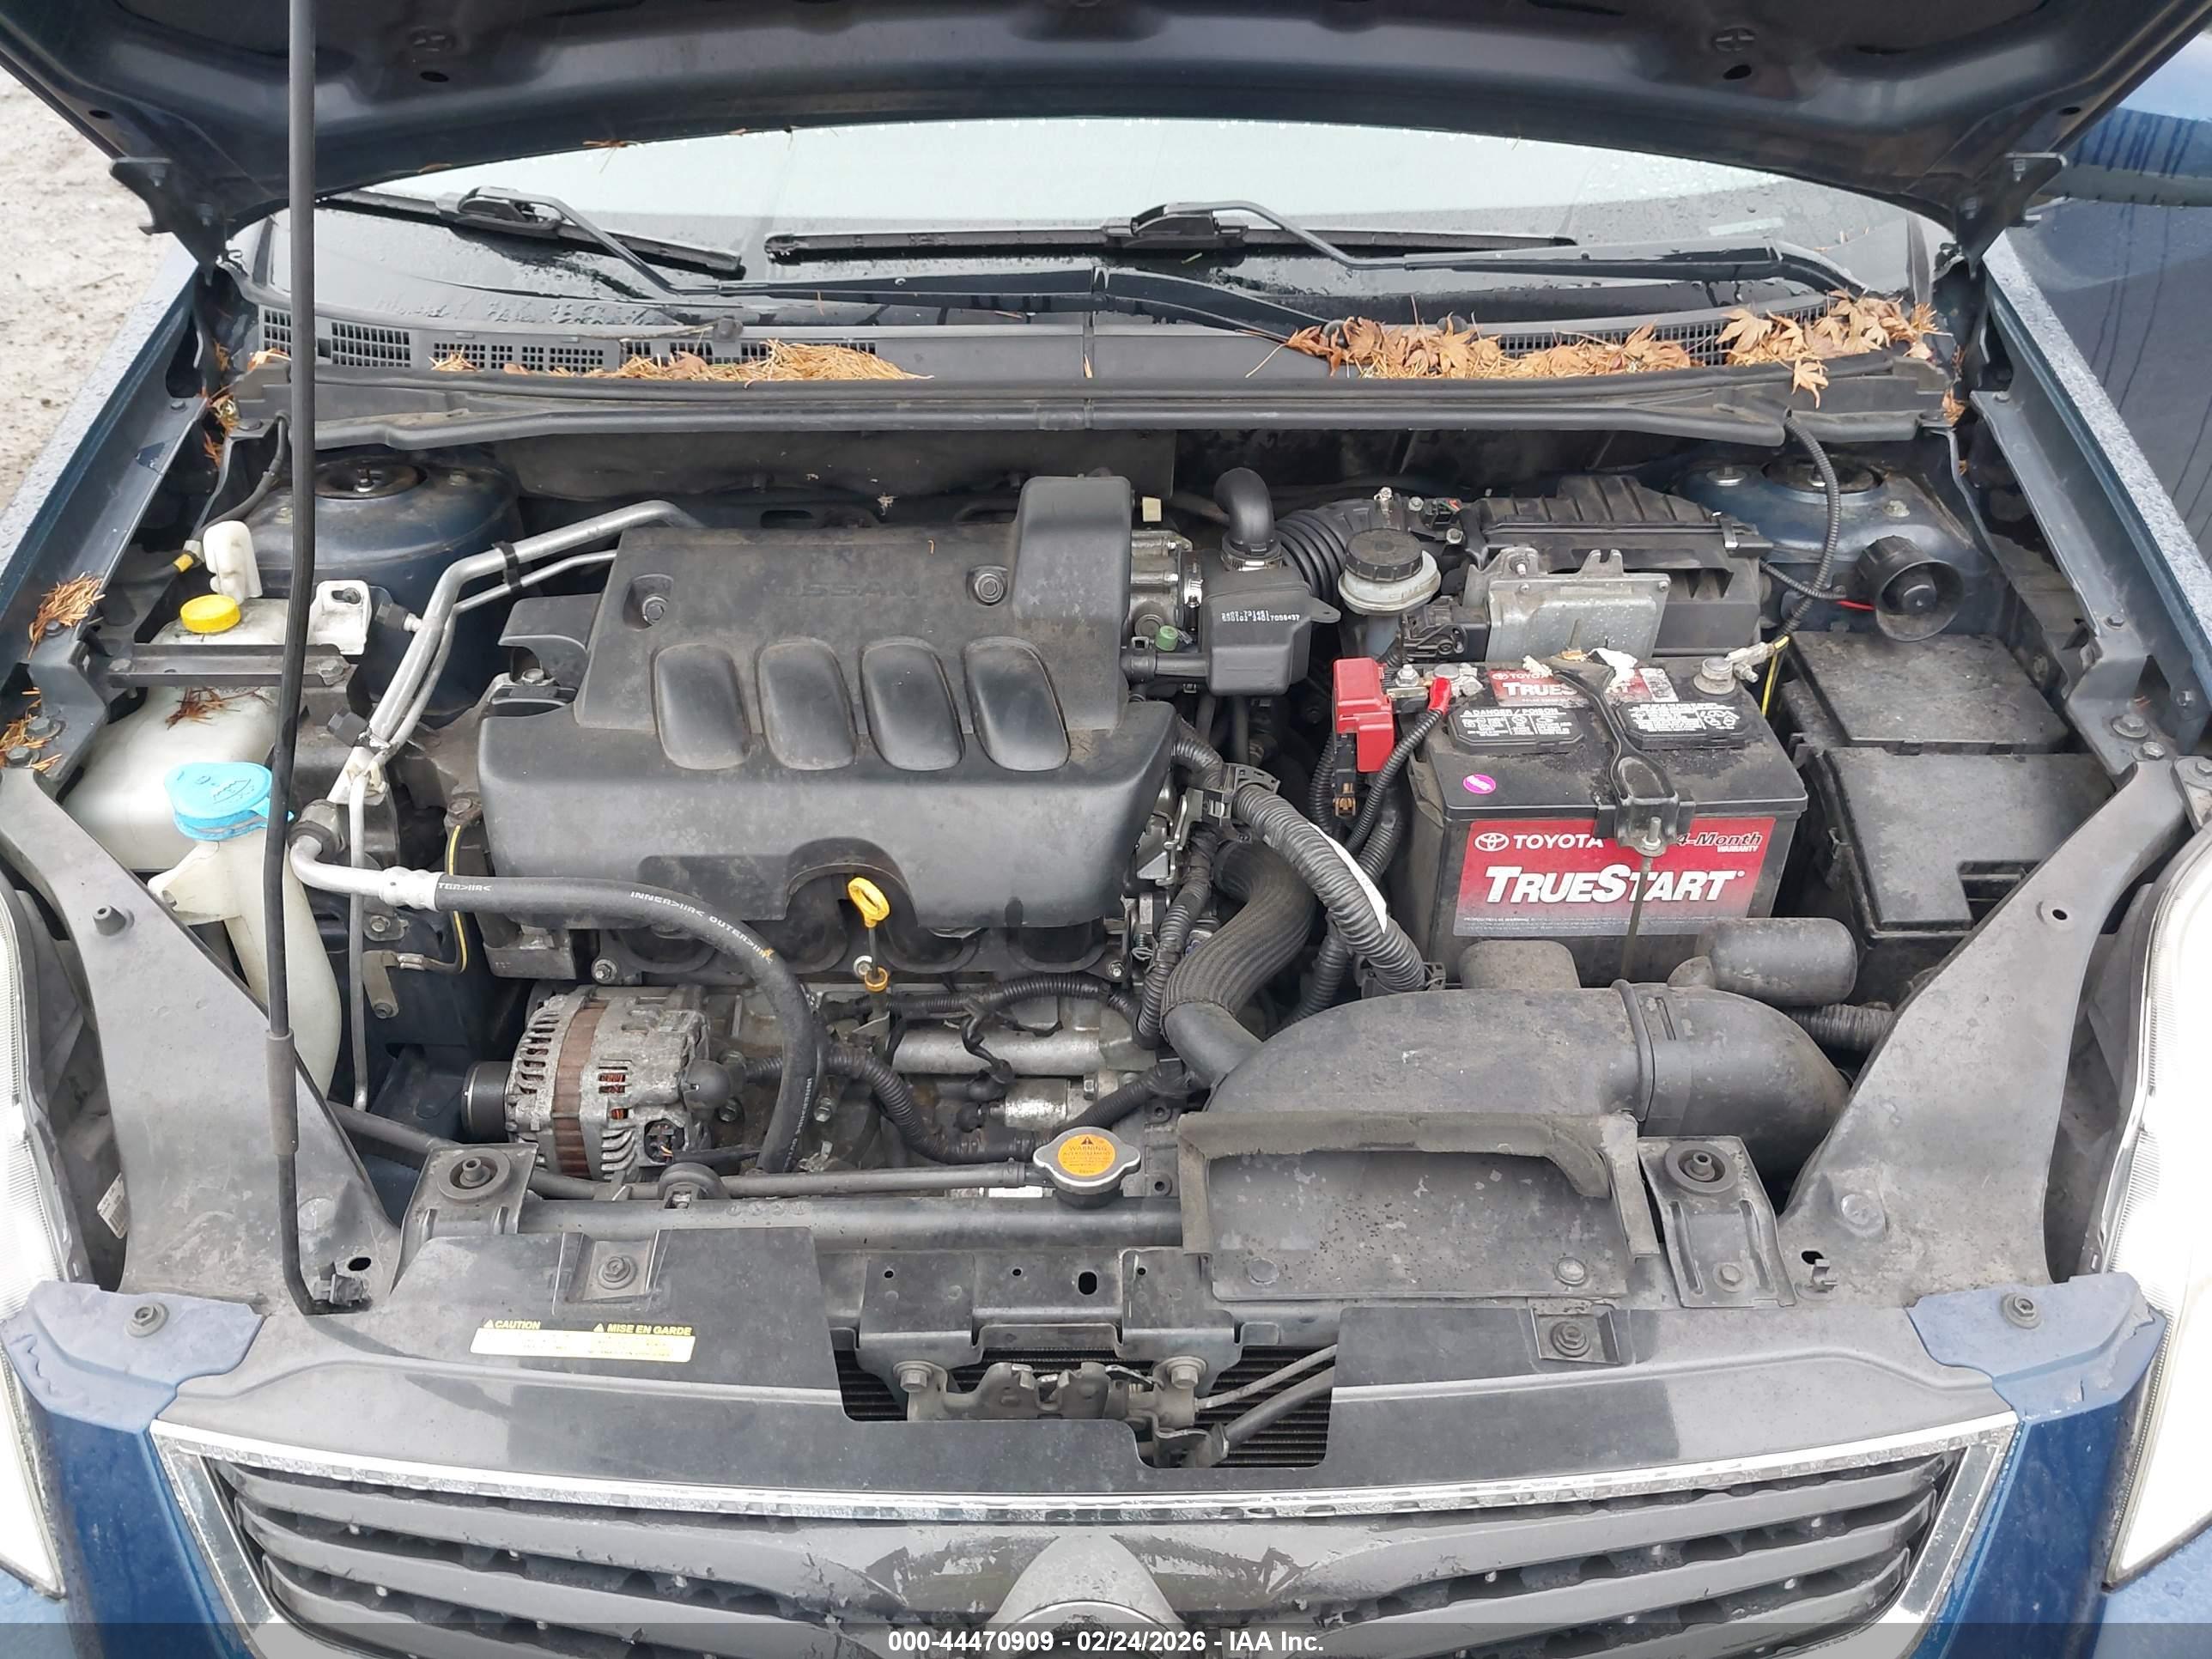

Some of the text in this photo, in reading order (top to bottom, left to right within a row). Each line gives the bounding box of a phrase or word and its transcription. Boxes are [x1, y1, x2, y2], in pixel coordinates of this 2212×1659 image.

[1512, 833, 1605, 849] TOYOTA
[495, 1319, 693, 1336] CAUTION MISE EN GARDE
